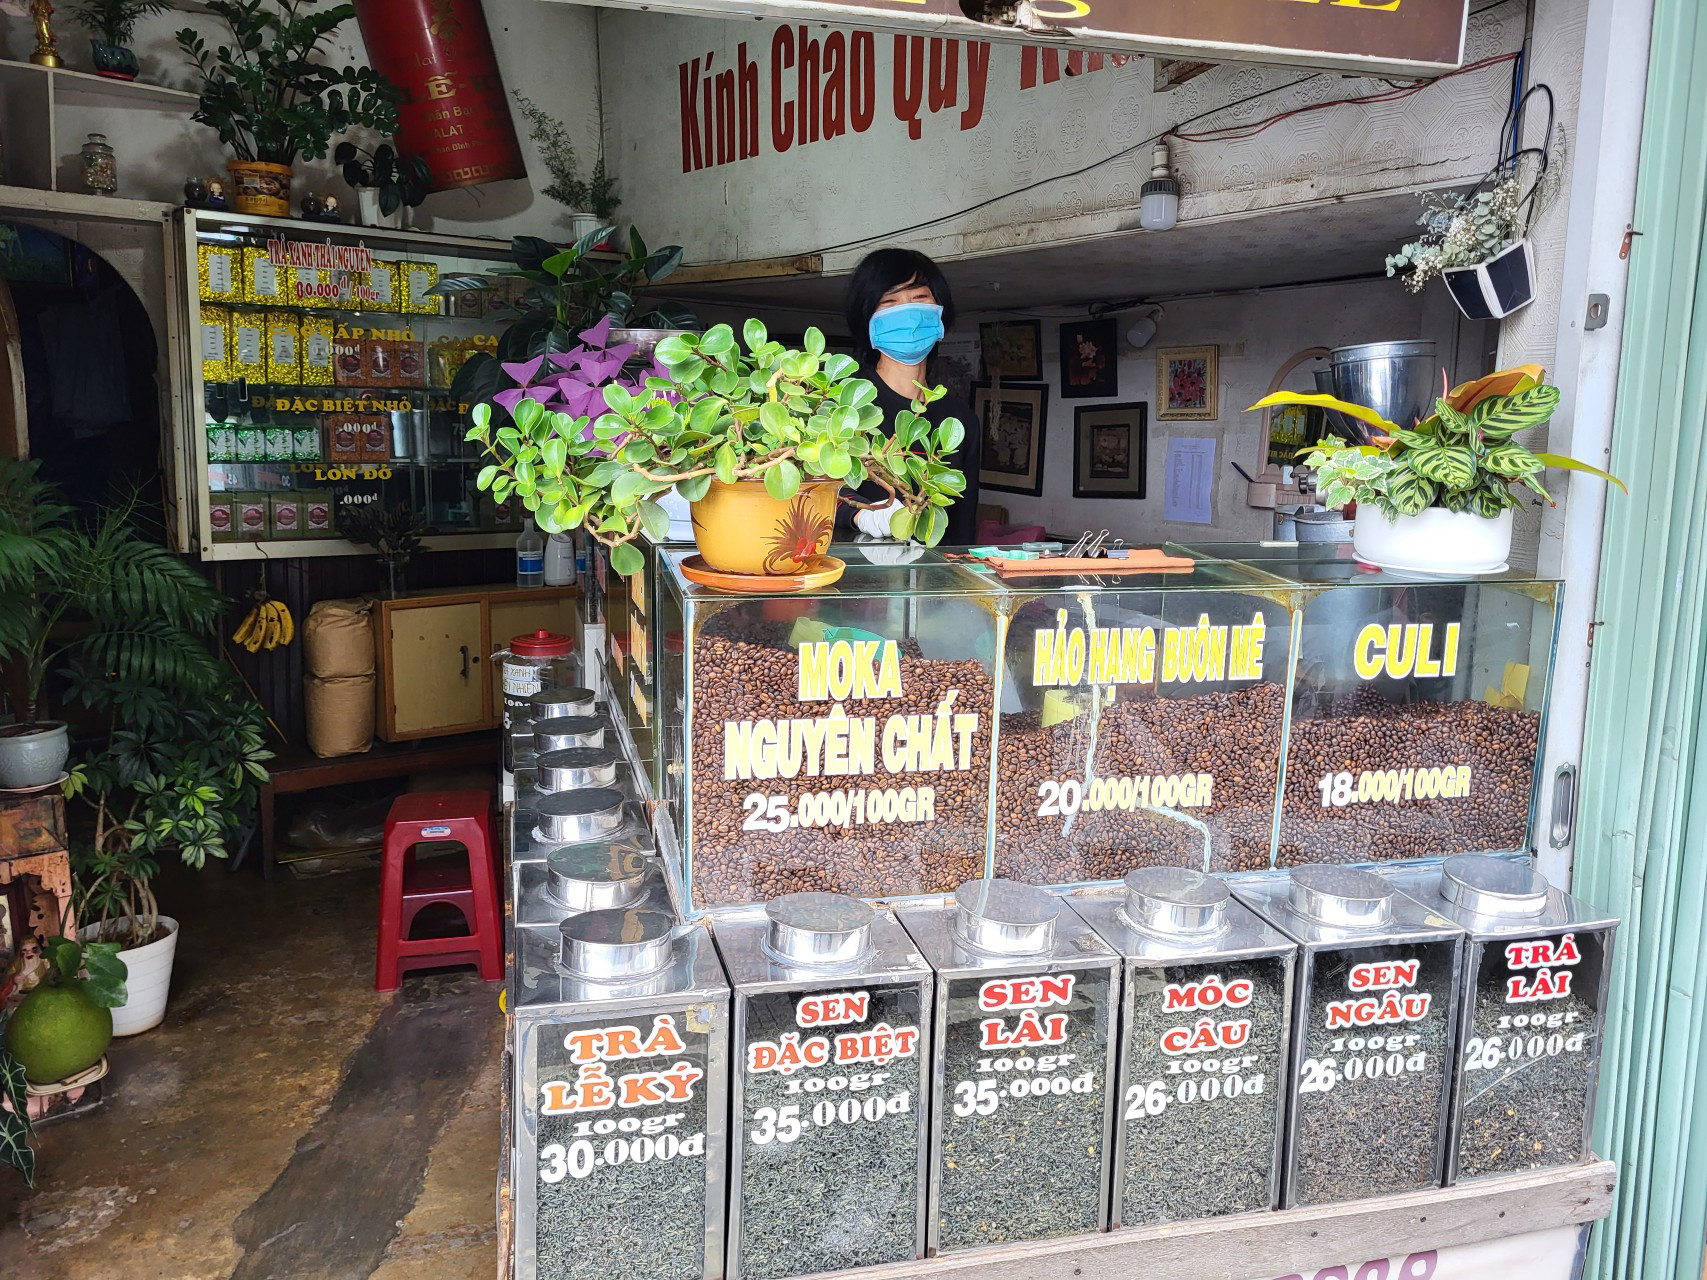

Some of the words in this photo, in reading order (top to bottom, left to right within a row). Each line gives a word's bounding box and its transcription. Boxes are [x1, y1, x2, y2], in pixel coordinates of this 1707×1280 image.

[679, 41, 759, 173] Kính
[427, 124, 464, 138] ALAT
[287, 240, 313, 268] XANH
[337, 240, 372, 273] NGUYÊN
[370, 326, 415, 342] NHỎ
[276, 396, 319, 415] ĐẶC
[322, 396, 365, 414] BIỆT
[368, 396, 412, 412] NHỎ
[315, 468, 359, 481] LON
[364, 462, 392, 481] ĐỎ
[1032, 607, 1086, 687] HẢO
[1161, 613, 1228, 683] BUÔN
[1229, 611, 1266, 681] MÊ
[1353, 621, 1462, 682] CULI
[798, 639, 903, 702] MOKA
[724, 704, 875, 780] NGUYÊN
[882, 690, 979, 772] CHẤT
[1037, 773, 1214, 818] 20.000/100GR
[1317, 765, 1472, 809] 18.000/100GR
[742, 787, 935, 833] 25.000/100GR
[1505, 933, 1581, 970] TRÀ
[978, 974, 1076, 1011] SEN
[1162, 974, 1254, 1013] MÓC
[1348, 959, 1420, 992] SEN
[1506, 968, 1573, 1003] LÀI
[796, 991, 870, 1028] SEN
[980, 1009, 1069, 1050] LÀI
[1326, 990, 1432, 1030] NGÂU
[1496, 1011, 1579, 1029] 100gr
[564, 1014, 686, 1064] TRÀ
[747, 1031, 829, 1075] ĐẶC
[834, 1022, 919, 1066] BIỆT
[1160, 1017, 1252, 1056] CÂU
[1330, 1034, 1421, 1052] 100gr
[1464, 1032, 1586, 1072] 26.000đ
[976, 1054, 1076, 1072] 100gr
[1165, 1054, 1258, 1074] 100gr
[1299, 1051, 1427, 1094] 26.000đ
[541, 1062, 616, 1115] LỄ
[618, 1061, 703, 1108] KÝ
[784, 1072, 891, 1095] 100gr
[953, 1071, 1094, 1117] 35.000đ
[1124, 1073, 1265, 1120] 26.000đ
[573, 1113, 685, 1137] 100gr
[750, 1091, 911, 1145] 35.000đ
[540, 1133, 705, 1184] 30.000đ
